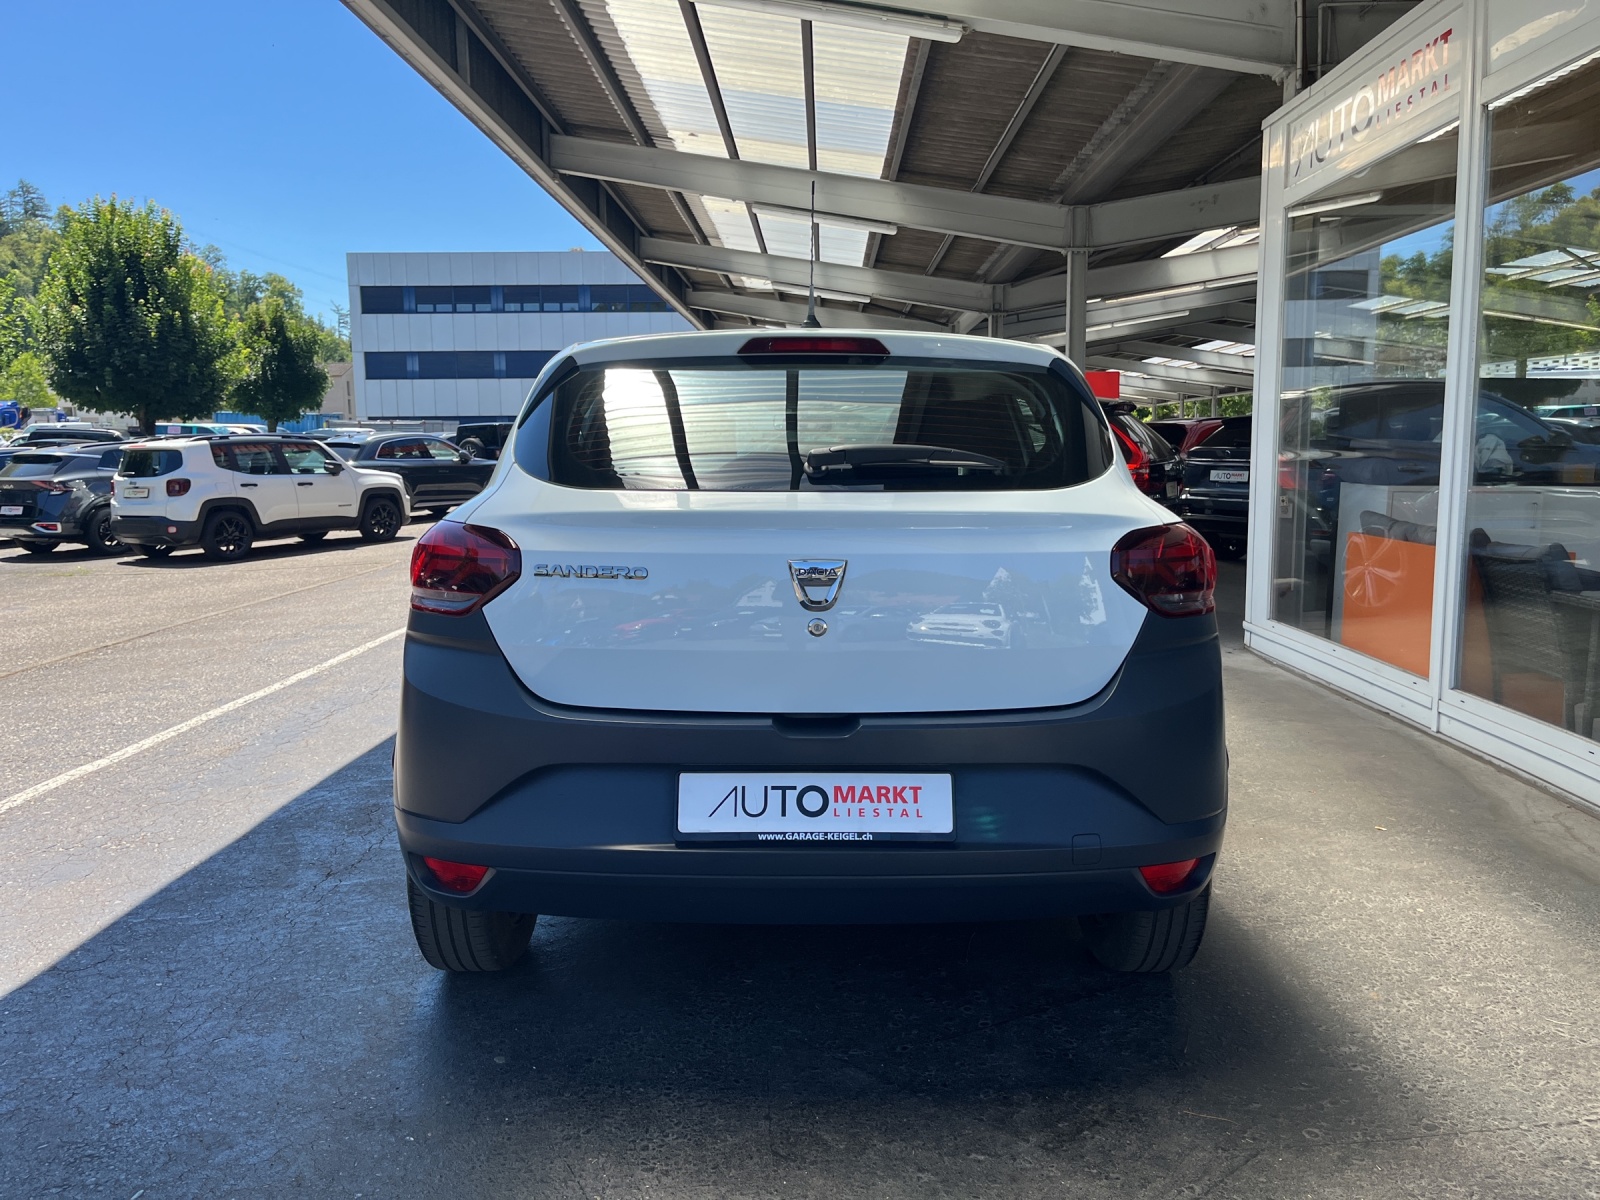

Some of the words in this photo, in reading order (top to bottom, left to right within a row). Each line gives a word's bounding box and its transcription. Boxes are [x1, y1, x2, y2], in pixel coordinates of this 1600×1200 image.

[1294, 84, 1377, 177] AUTO
[1377, 27, 1453, 103] MARKT
[1376, 73, 1451, 130] LIESTAL
[533, 563, 649, 580] SANDERO
[796, 568, 838, 576] DACIA
[708, 784, 829, 818] AUTO
[833, 785, 923, 804] MARKT
[833, 807, 923, 818] LIESTAL
[758, 832, 873, 841] www.GARAGE-KEIGEL.ch
